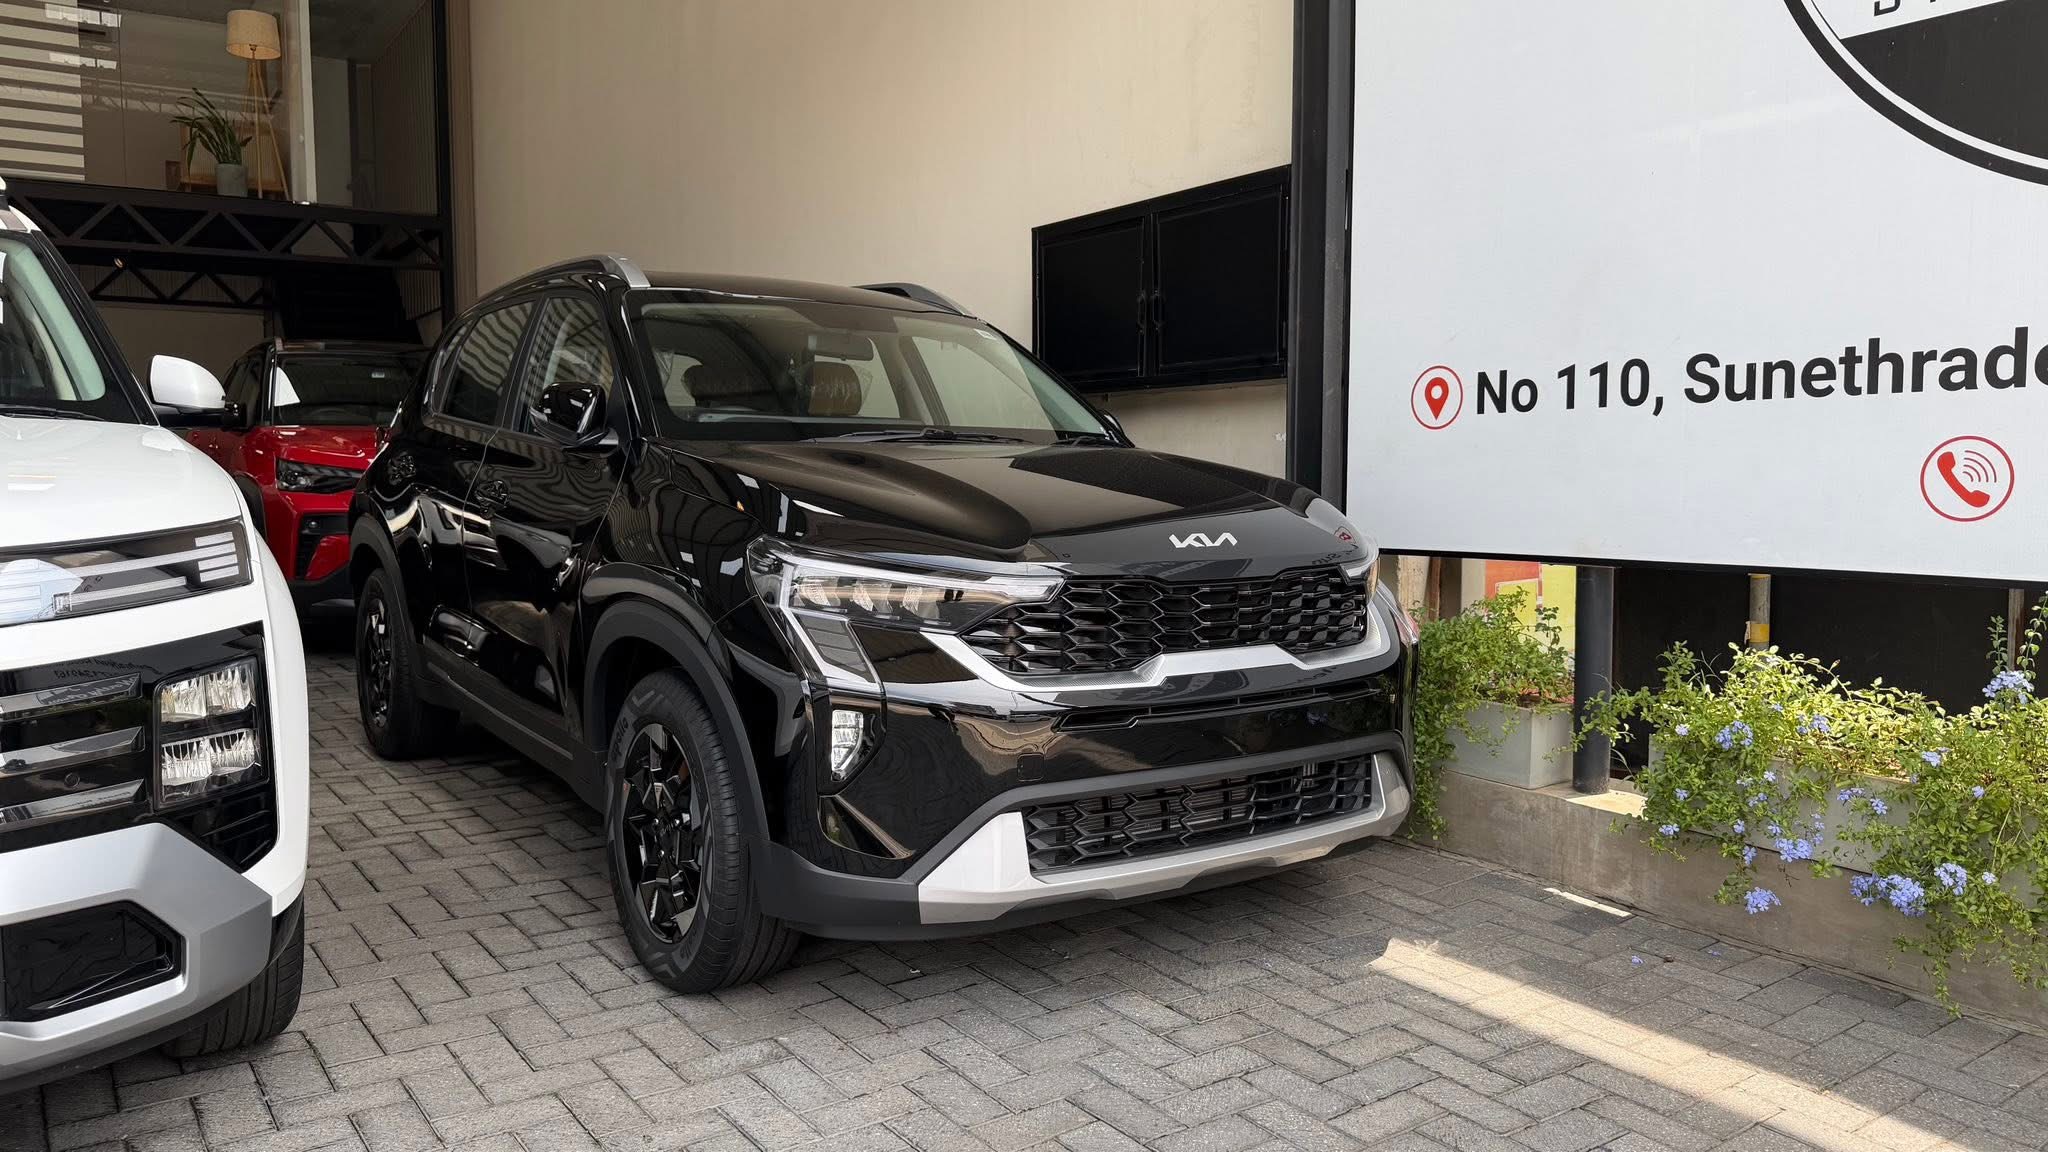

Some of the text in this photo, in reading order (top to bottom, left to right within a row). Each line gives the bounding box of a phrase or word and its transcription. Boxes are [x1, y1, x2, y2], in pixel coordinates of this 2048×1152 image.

[1476, 369, 1538, 415] No
[1557, 358, 1664, 417] 110,
[1168, 532, 1238, 549] KIA
